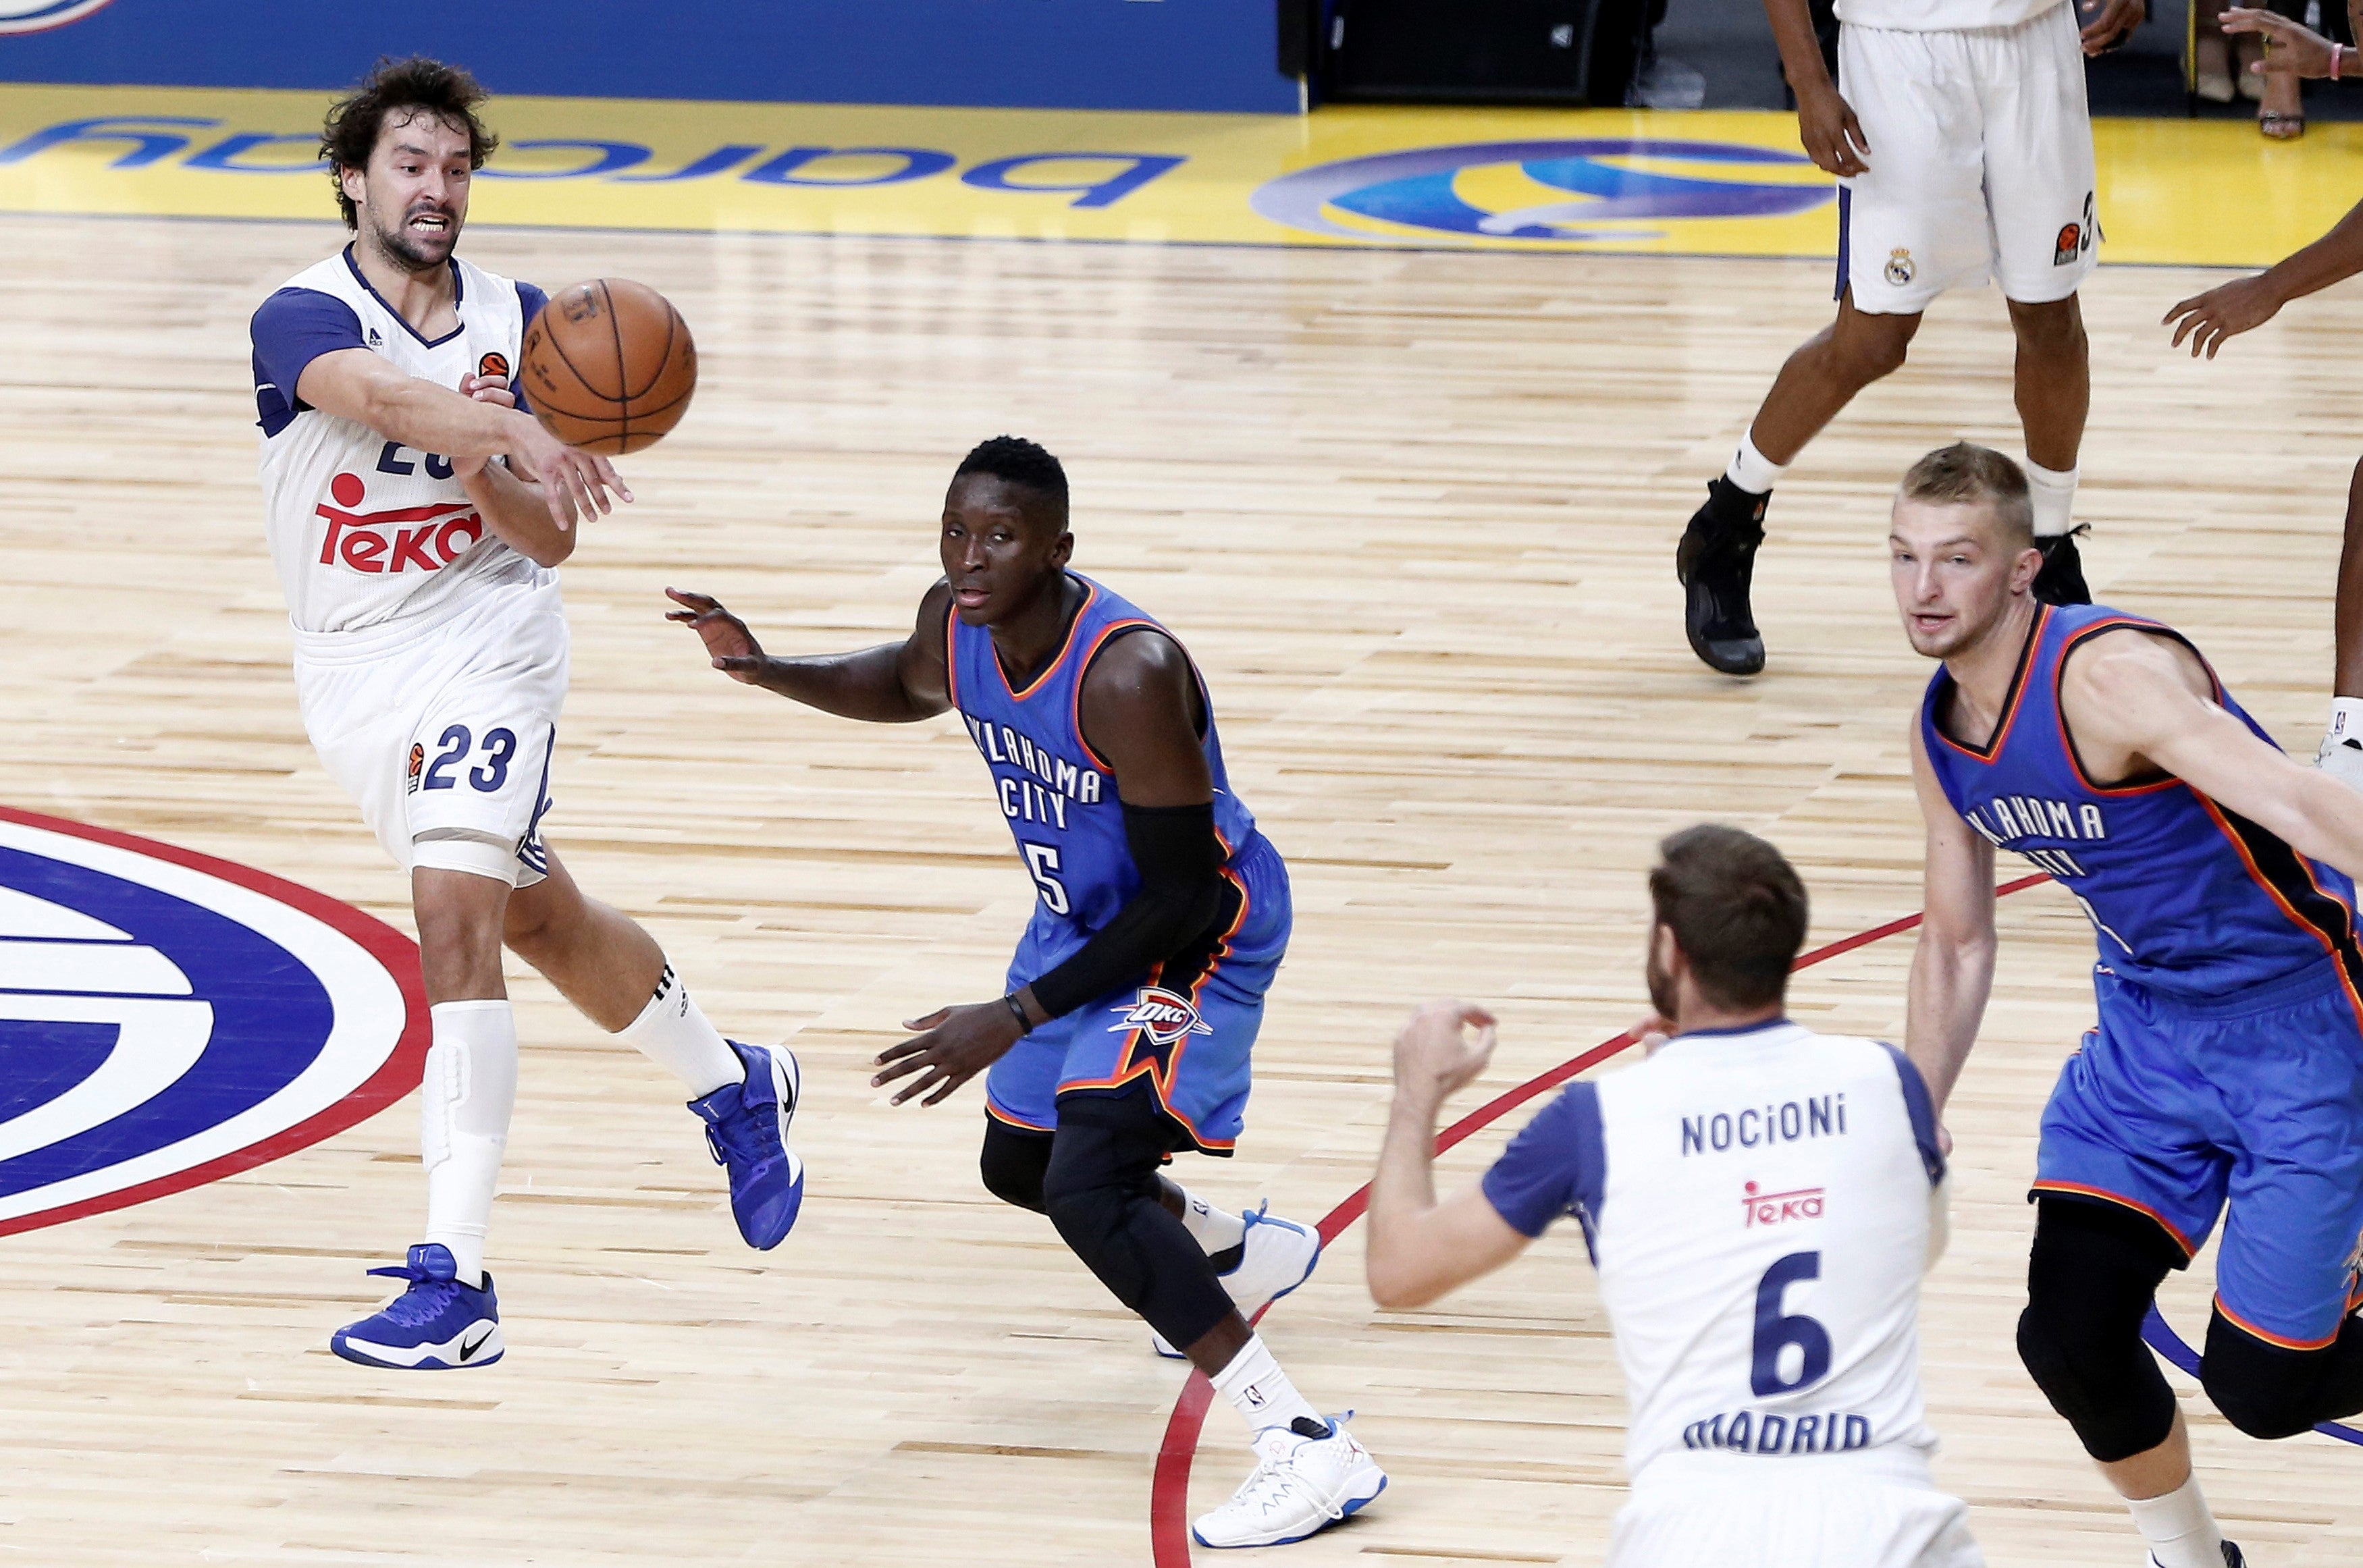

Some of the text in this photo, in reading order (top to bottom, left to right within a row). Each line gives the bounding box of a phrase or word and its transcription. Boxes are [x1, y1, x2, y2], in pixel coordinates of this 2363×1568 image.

[0, 113, 1188, 207] barcay
[423, 724, 516, 793] 23
[999, 778, 1068, 831] CITY
[1022, 842, 1071, 917] 5
[2024, 848, 2086, 877] ITY
[1127, 1001, 1187, 1023] OKC
[1751, 1250, 1833, 1397] 6
[1682, 1409, 1872, 1454] MADRID
